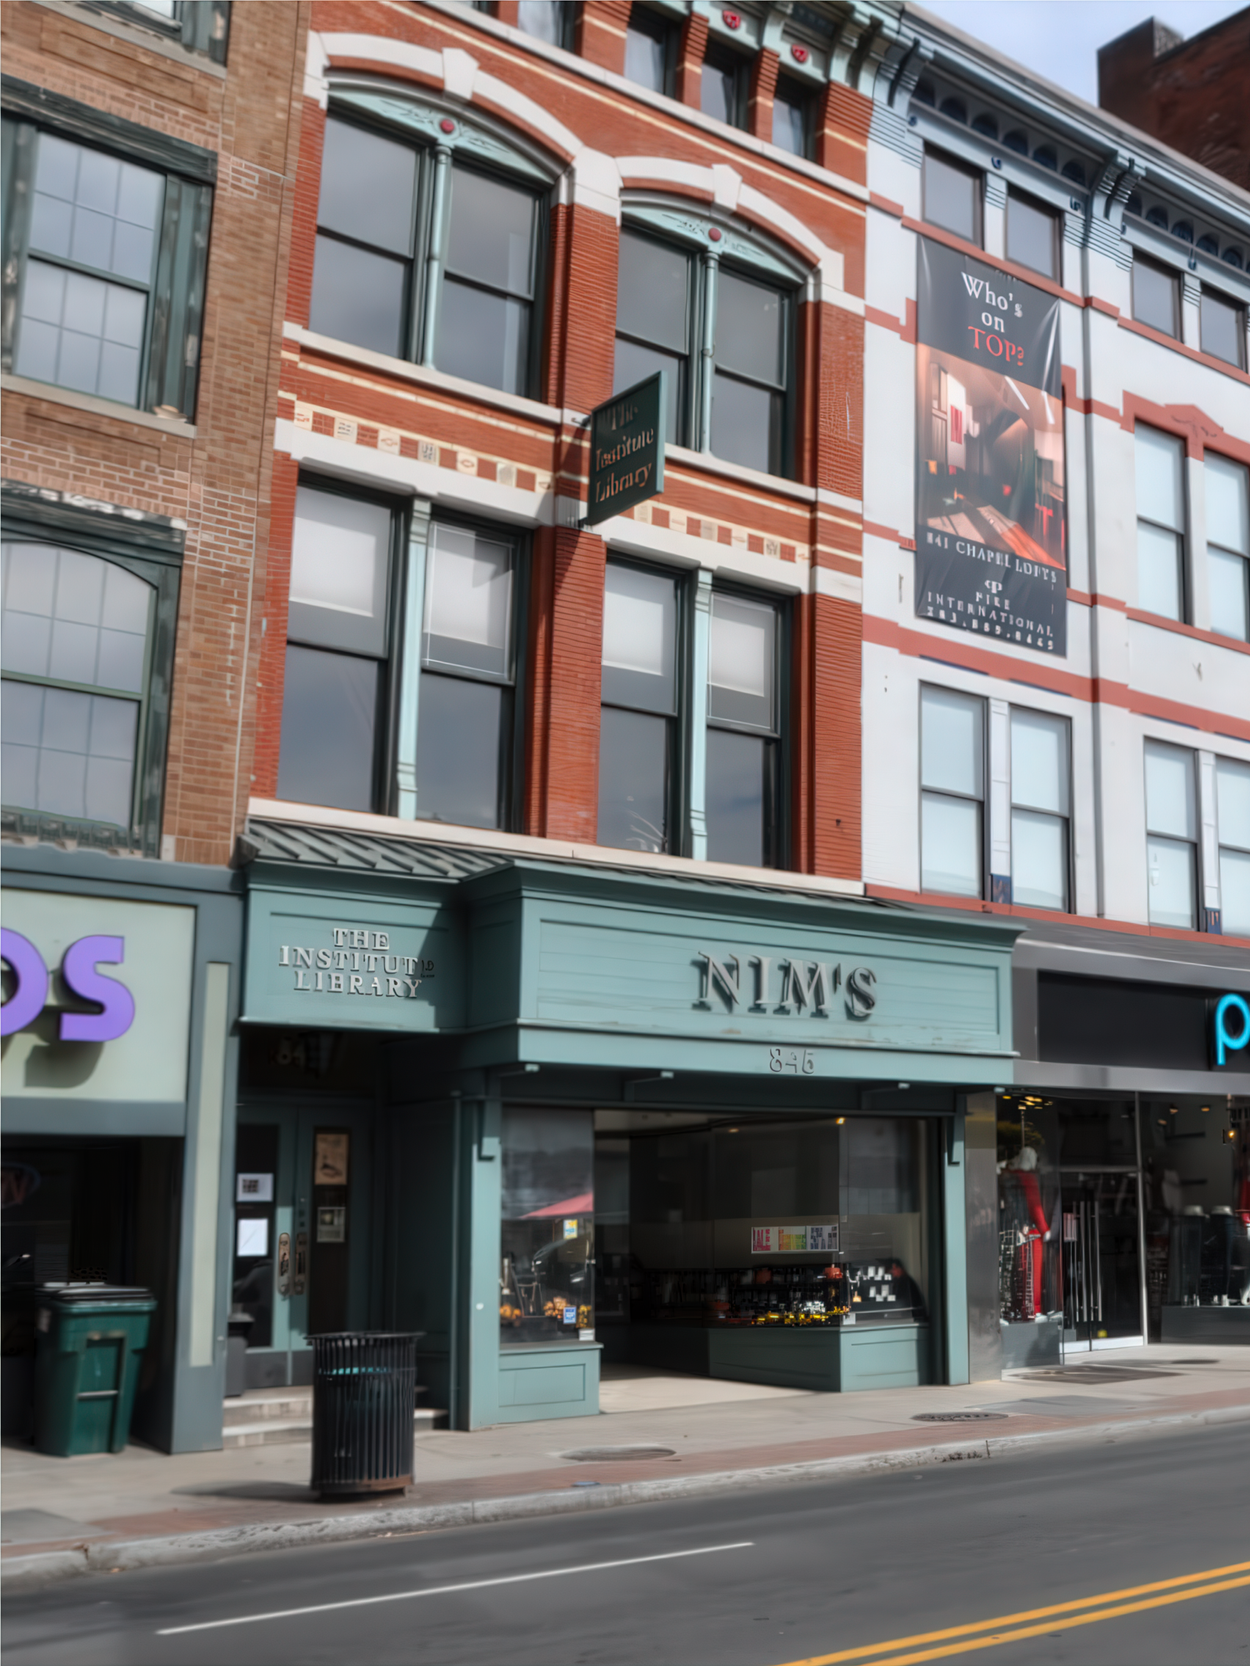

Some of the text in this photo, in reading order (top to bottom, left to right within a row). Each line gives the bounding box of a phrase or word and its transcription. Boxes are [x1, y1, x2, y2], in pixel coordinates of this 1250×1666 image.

[961, 271, 1024, 318] Who's
[981, 311, 1005, 333] on
[967, 325, 1025, 366] TOP?
[595, 463, 653, 503] Library
[333, 927, 390, 951] THE
[293, 970, 422, 998] LIBRARY
[692, 951, 877, 1021] NIM'S
